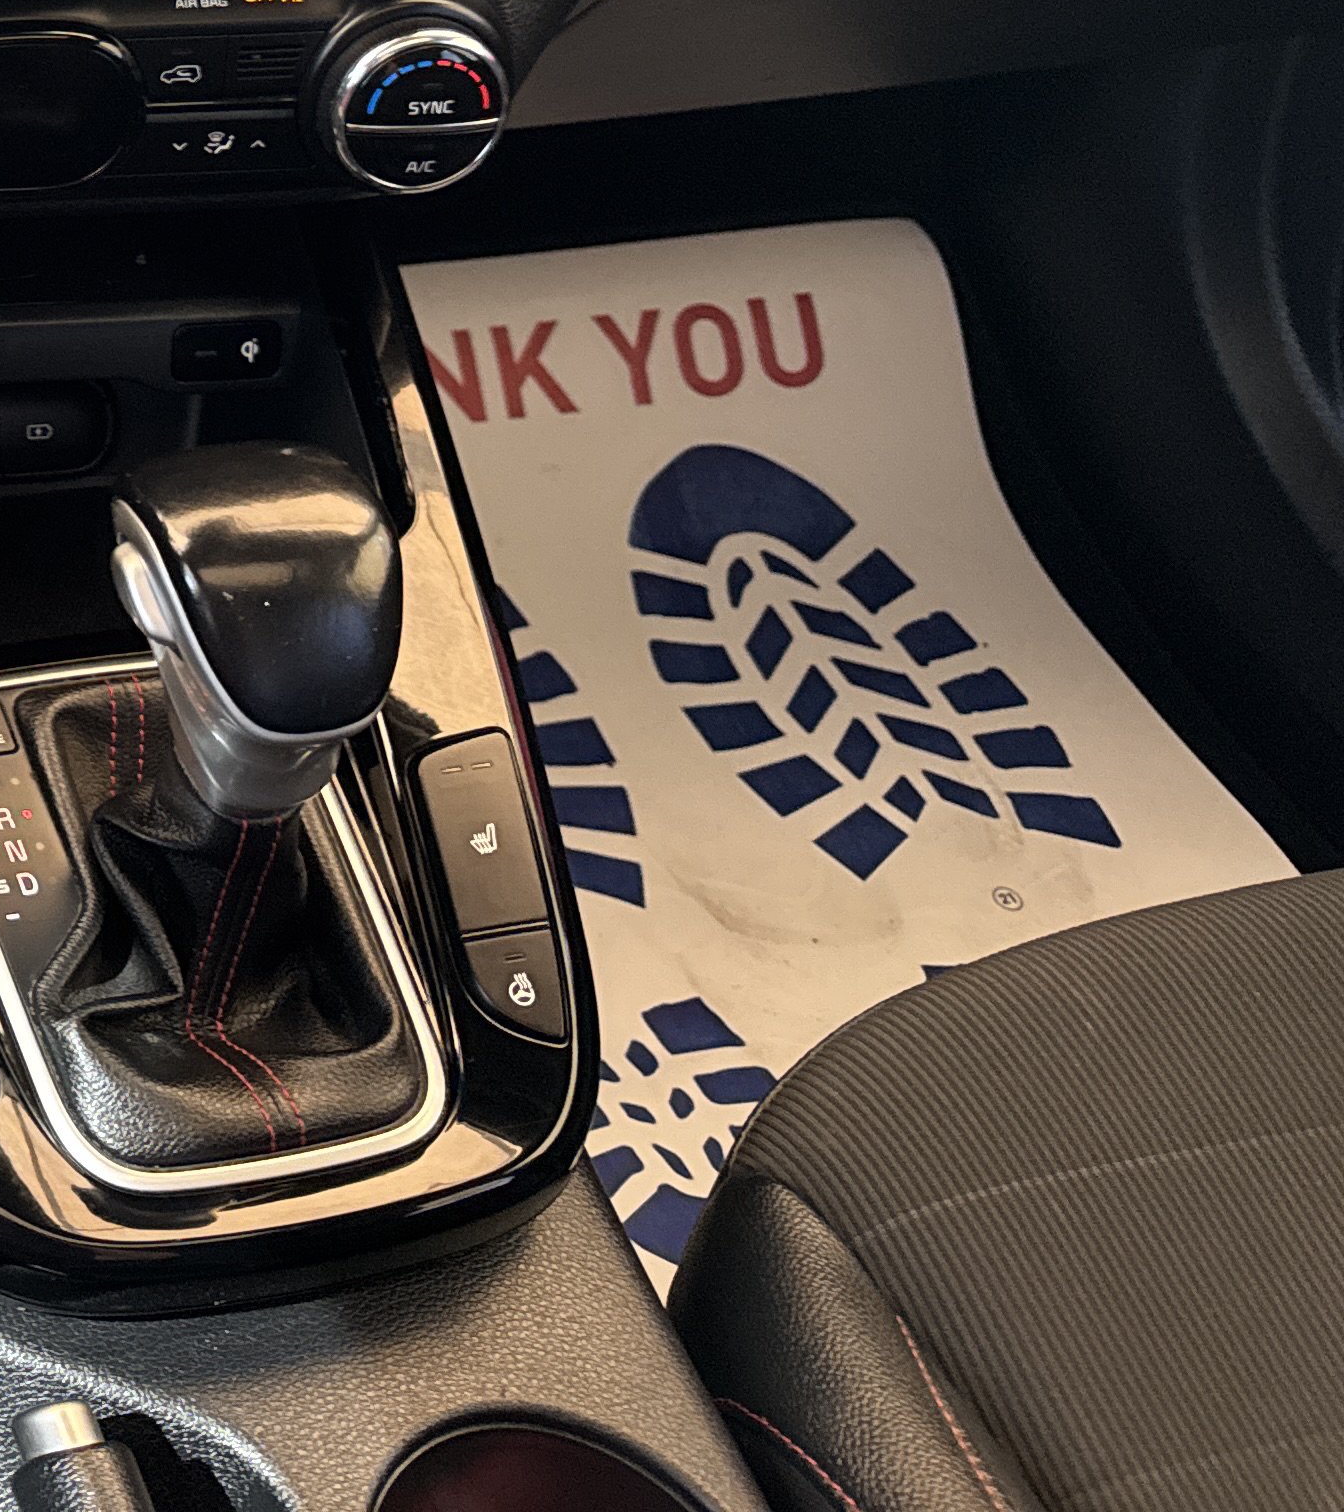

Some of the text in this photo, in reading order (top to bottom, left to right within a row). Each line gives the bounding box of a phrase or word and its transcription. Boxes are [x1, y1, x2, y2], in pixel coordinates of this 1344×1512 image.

[407, 100, 456, 116] SYNC
[404, 160, 436, 174] A/C
[591, 292, 825, 406] YOU
[5, 840, 28, 863] N
[17, 873, 39, 896] D
